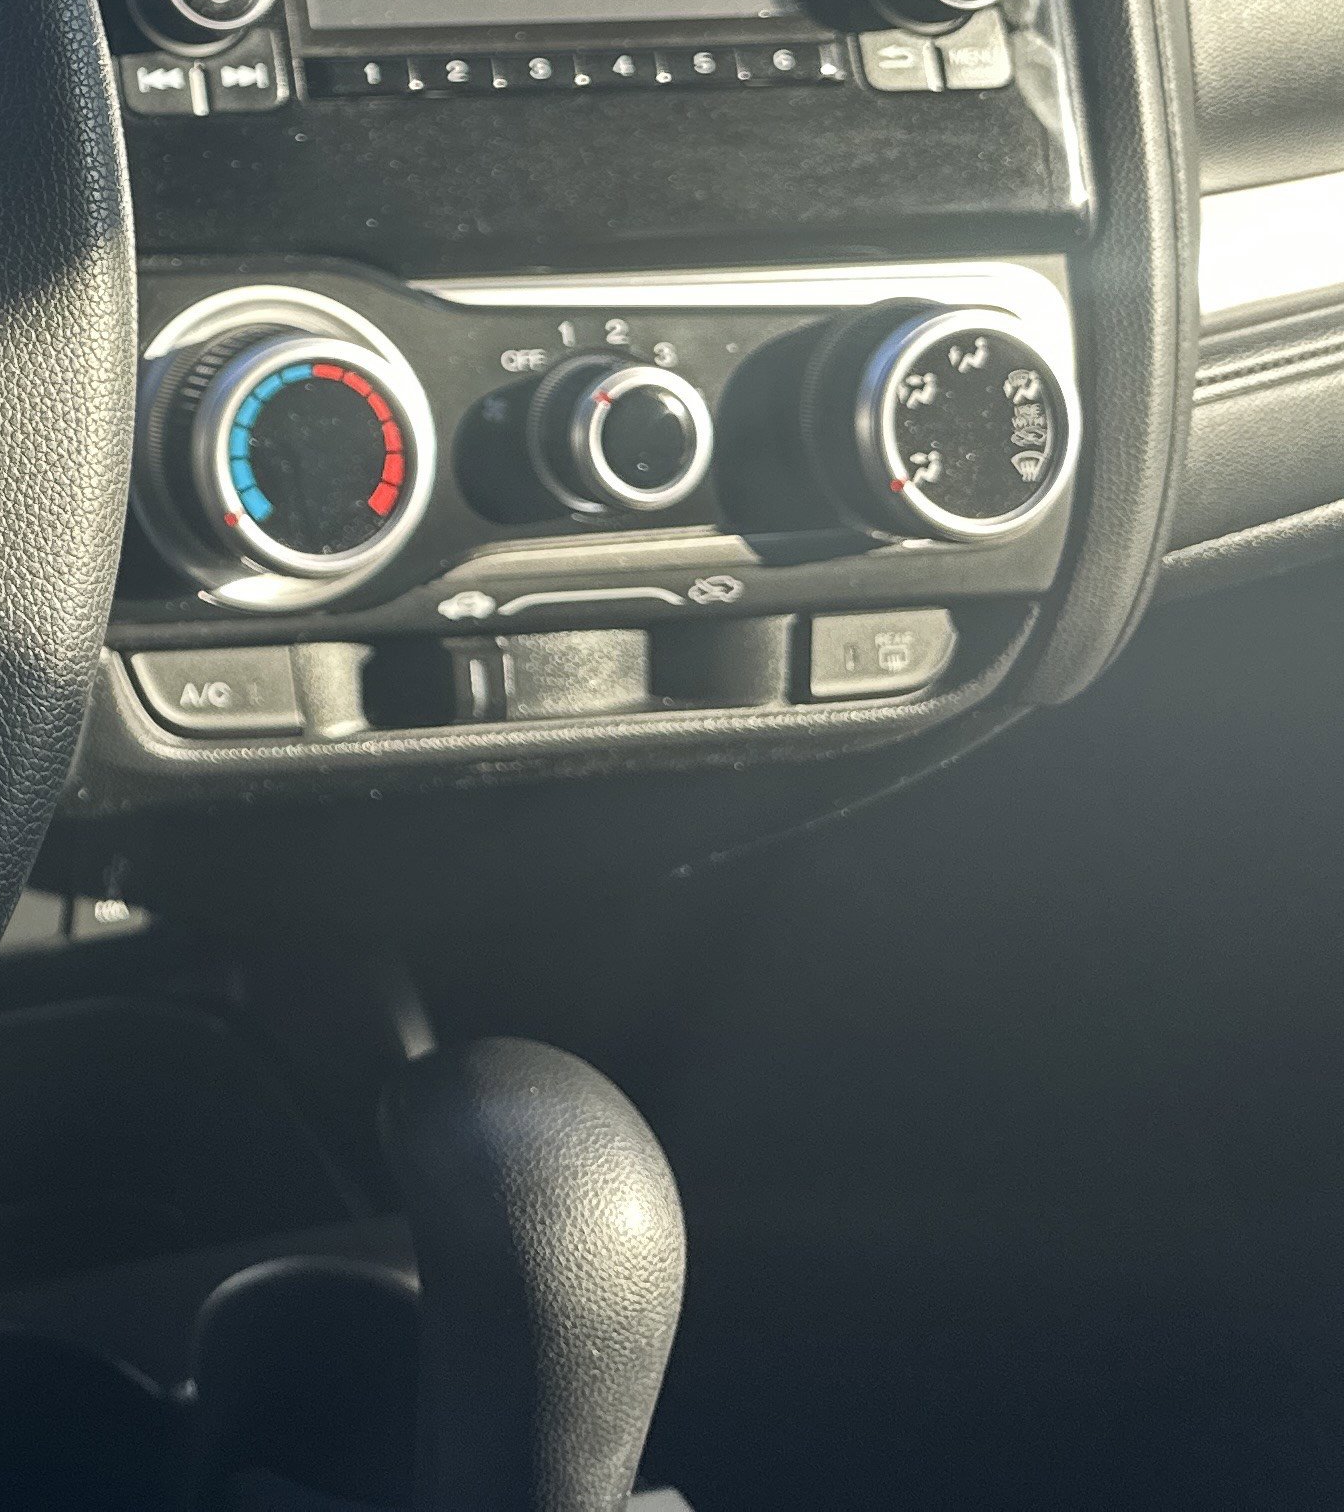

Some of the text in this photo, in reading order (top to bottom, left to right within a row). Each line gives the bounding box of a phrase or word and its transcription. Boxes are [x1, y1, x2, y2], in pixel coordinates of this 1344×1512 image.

[364, 62, 381, 85] 1
[446, 59, 471, 83] 2
[528, 57, 553, 80] 3
[558, 320, 577, 346] 1
[605, 319, 629, 344] 2
[500, 348, 547, 373] OFF
[654, 342, 678, 367] 3
